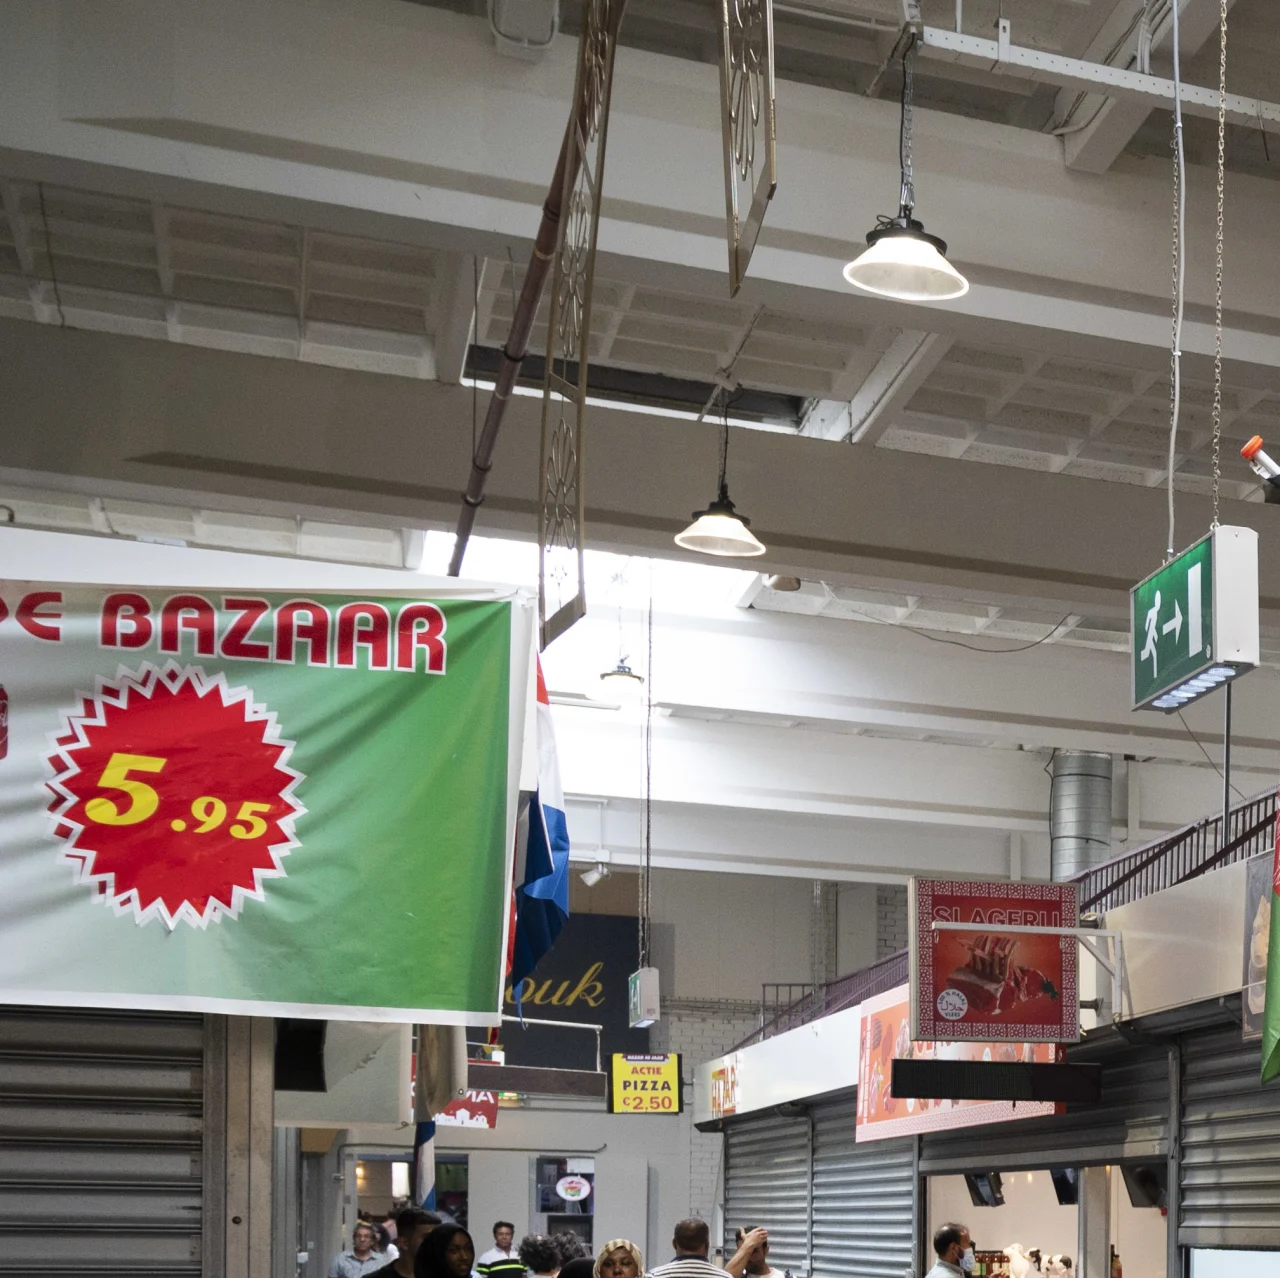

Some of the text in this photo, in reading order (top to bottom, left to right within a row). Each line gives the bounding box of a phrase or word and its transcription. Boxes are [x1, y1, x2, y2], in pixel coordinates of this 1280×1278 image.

[0, 592, 445, 673] E BAZAAR
[504, 962, 606, 1007] ouk
[631, 1066, 662, 1075] ACTIE
[622, 1080, 672, 1091] PIZZA
